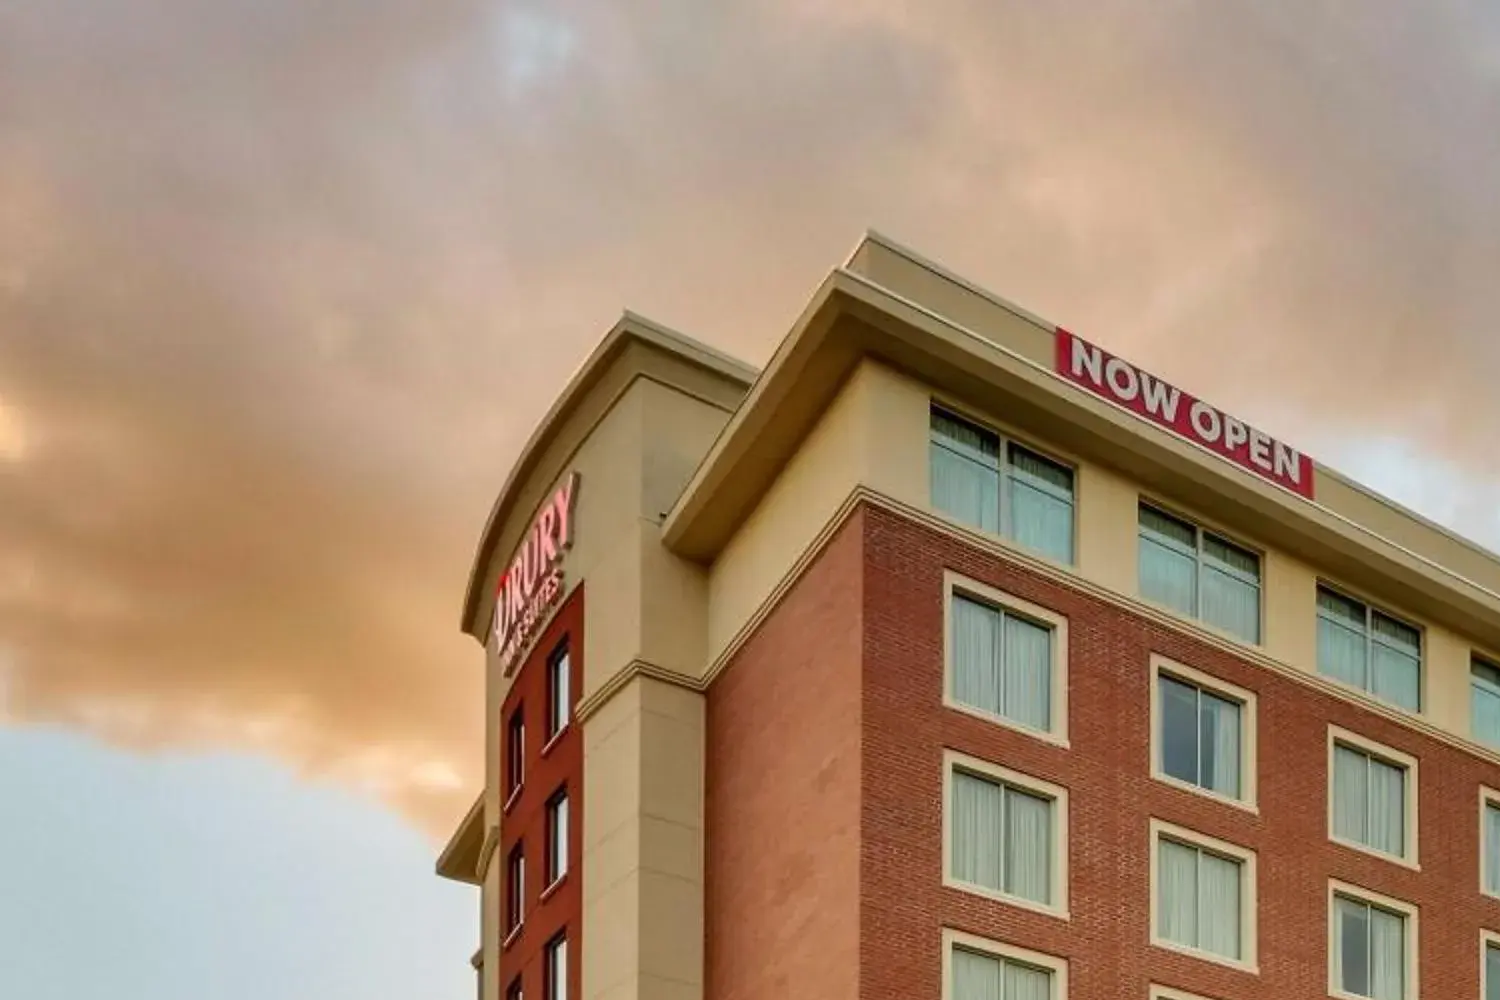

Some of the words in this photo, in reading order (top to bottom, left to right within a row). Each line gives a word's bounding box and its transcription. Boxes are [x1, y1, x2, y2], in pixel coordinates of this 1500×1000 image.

[1071, 338, 1180, 423] NOW
[1190, 401, 1301, 485] OPEN
[493, 472, 578, 656] DRURY
